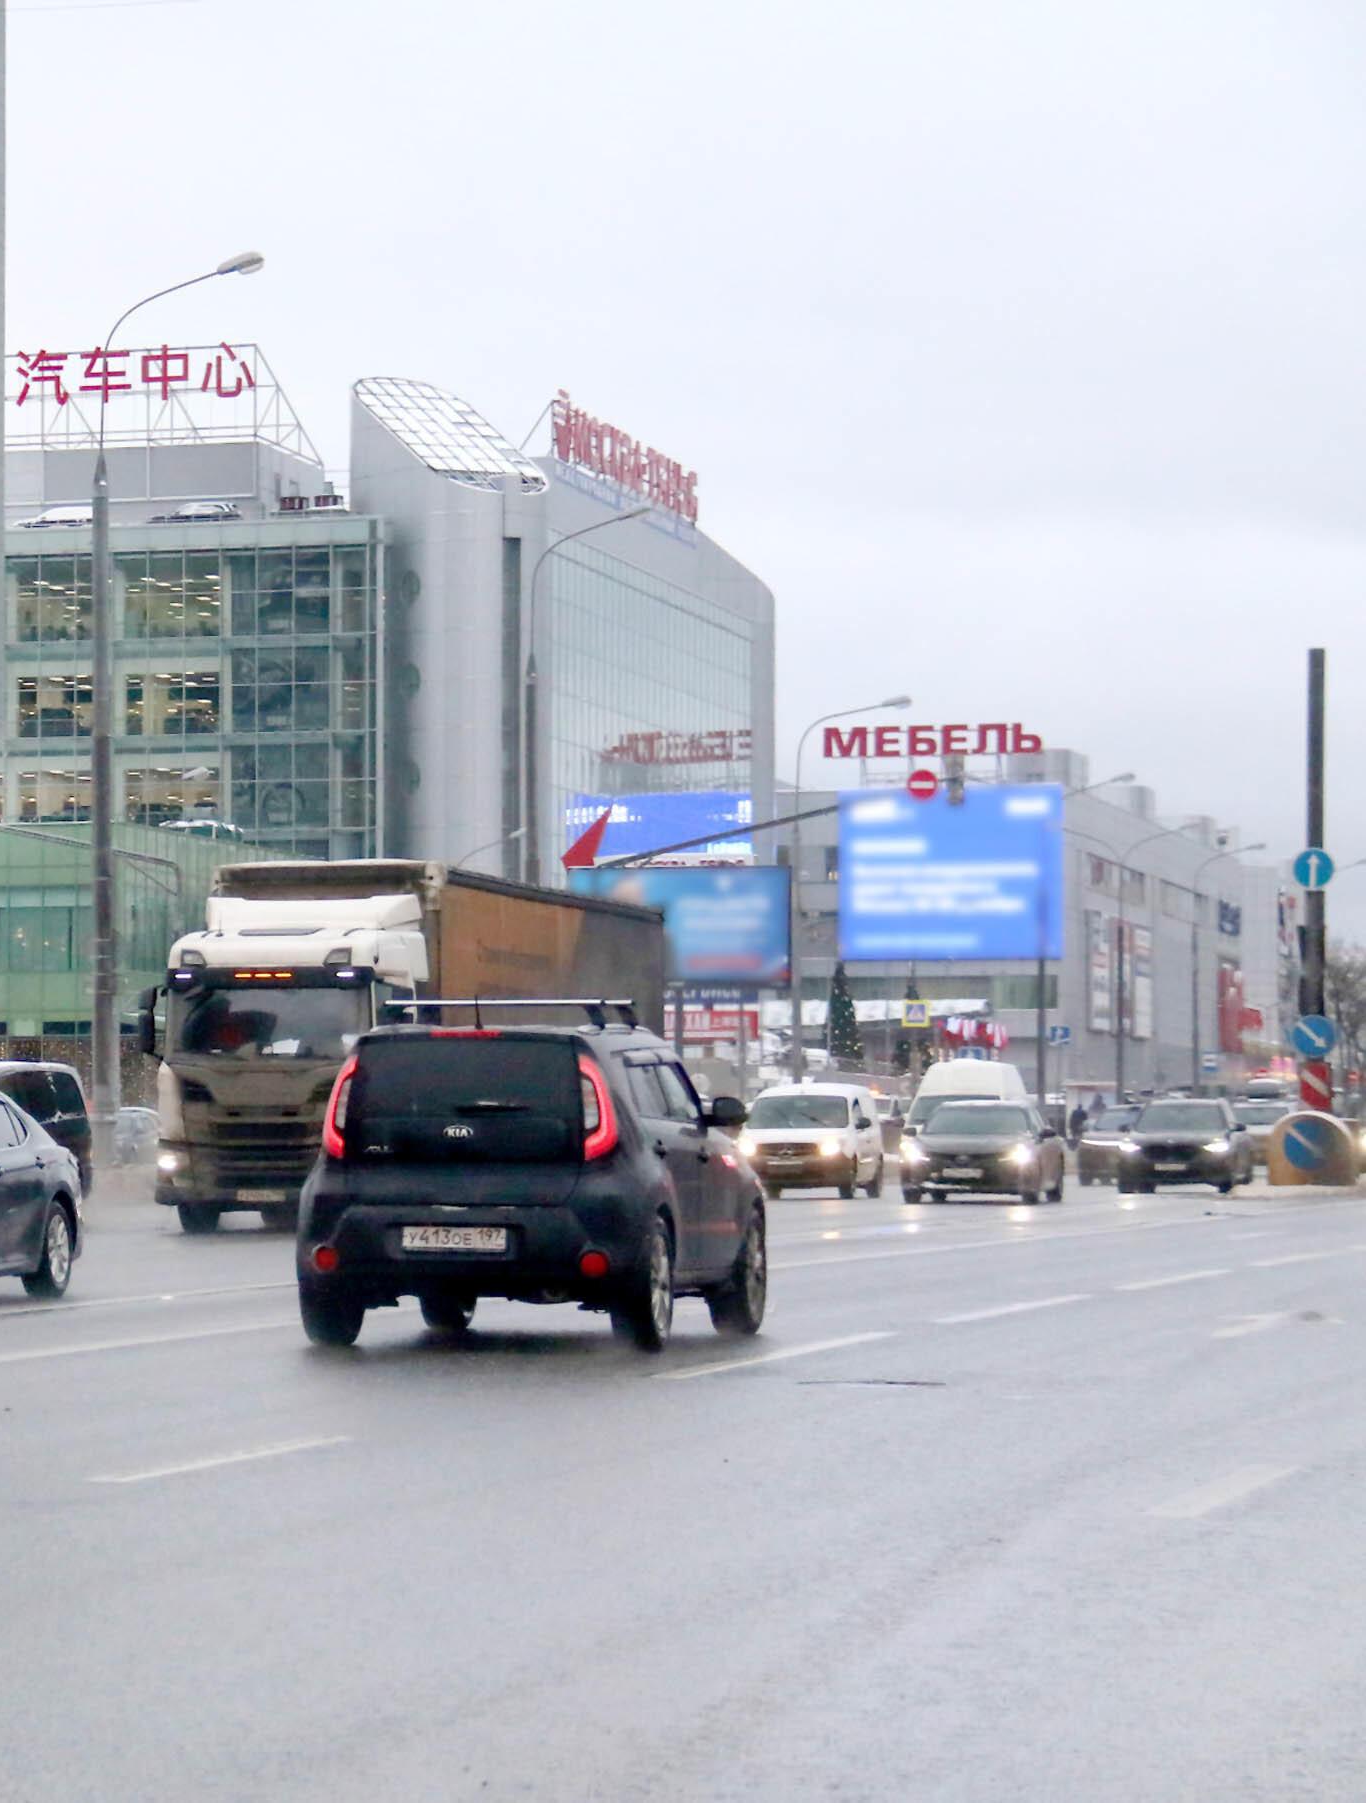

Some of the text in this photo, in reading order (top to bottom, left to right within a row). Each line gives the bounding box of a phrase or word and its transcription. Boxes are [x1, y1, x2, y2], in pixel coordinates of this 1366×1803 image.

[16, 342, 255, 406] 汽车中心
[824, 723, 1042, 758] МЕБЕЛЬ
[448, 1128, 469, 1137] KIA
